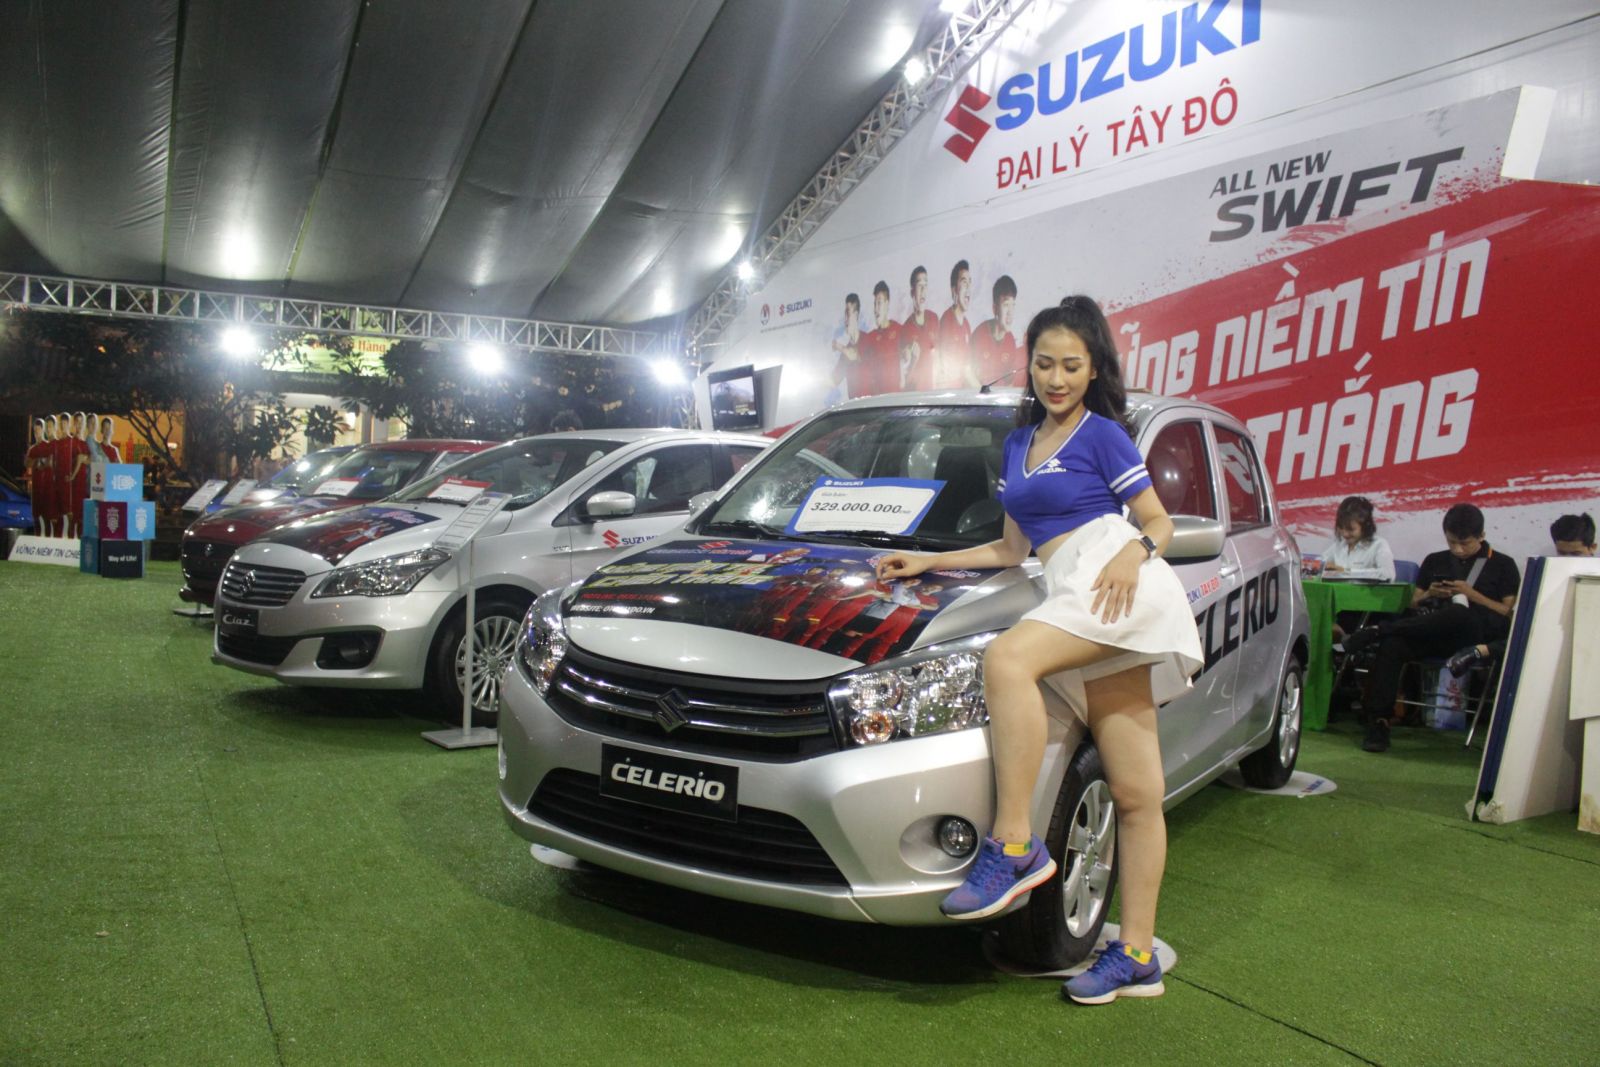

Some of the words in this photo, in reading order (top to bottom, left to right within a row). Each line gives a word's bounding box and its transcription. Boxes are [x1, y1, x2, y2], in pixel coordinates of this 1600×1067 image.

[995, 0, 1262, 131] SUZUKI
[997, 146, 1042, 189] ĐẠI
[1052, 125, 1089, 174] LÝ
[1107, 105, 1173, 156] TÂY
[1182, 77, 1238, 136] ĐÔ
[1209, 169, 1257, 199] ALL
[1265, 150, 1332, 186] NEW
[1209, 146, 1465, 242] SWIFT
[786, 299, 812, 313] SUZUKI
[1246, 351, 1480, 485] THẮNG
[811, 502, 902, 514] 329.000.000
[1192, 566, 1279, 683] ELERIO
[611, 763, 725, 801] CELERIO
